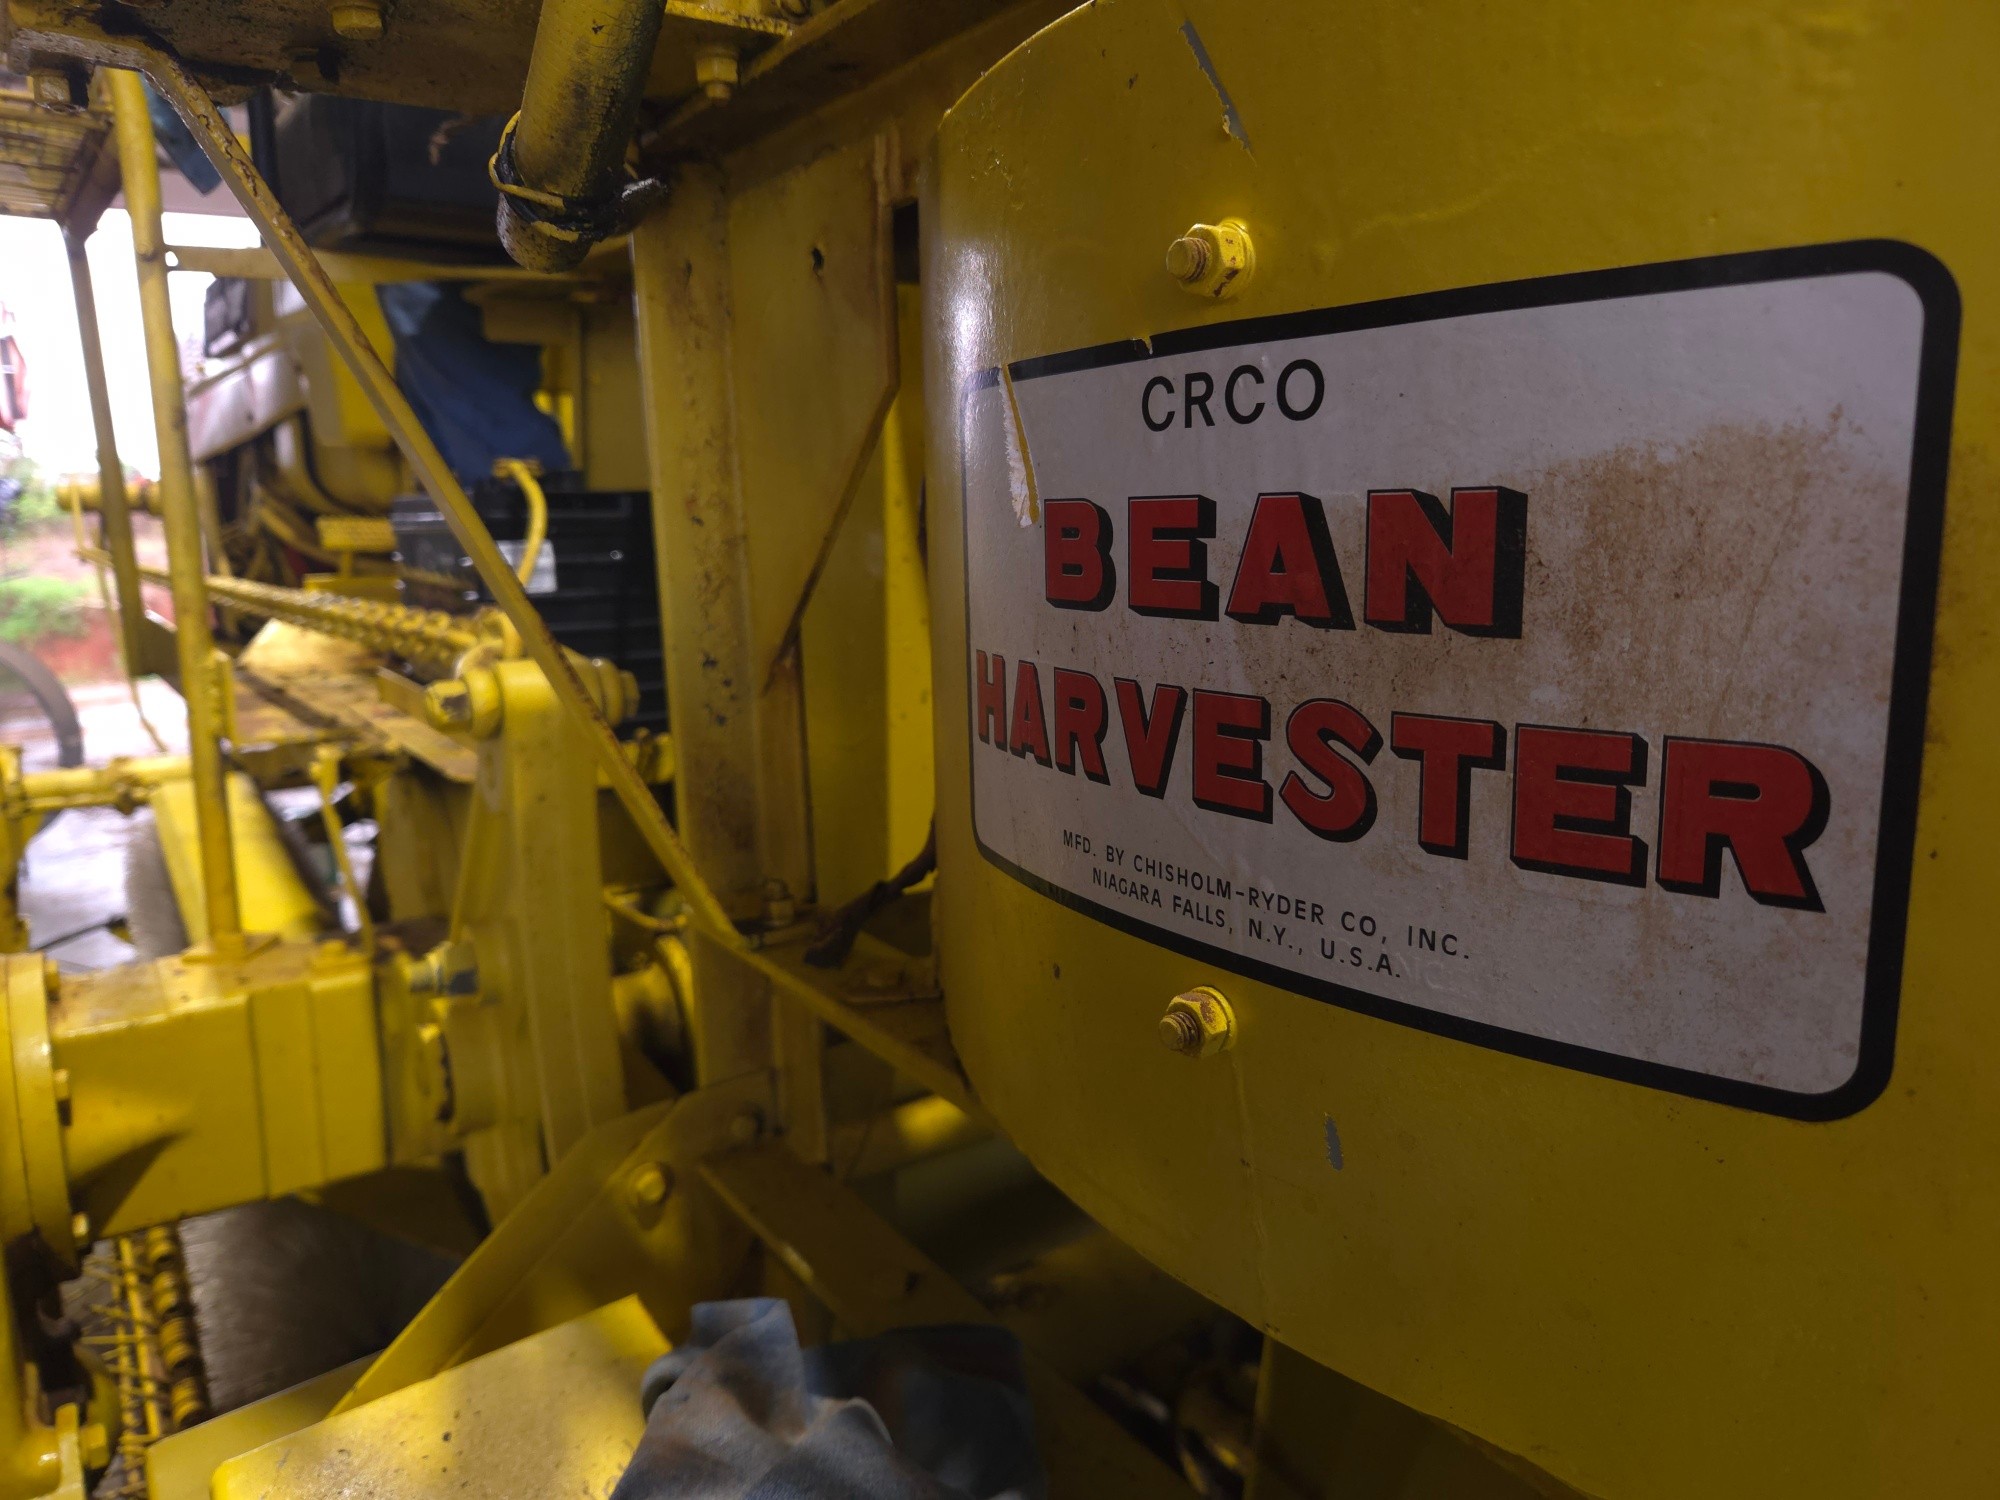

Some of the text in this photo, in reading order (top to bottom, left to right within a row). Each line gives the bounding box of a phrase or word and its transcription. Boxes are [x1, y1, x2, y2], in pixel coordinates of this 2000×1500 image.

[1141, 358, 1325, 432] CRCO
[1043, 485, 1529, 640] BEAN
[975, 648, 1831, 914] HARVESTER
[1062, 829, 1471, 960] MFD. BY CHISHOLM-RYDER CO, INC.
[1092, 867, 1402, 979] NIAGARA FALLS, N.Y., U.S.A.
